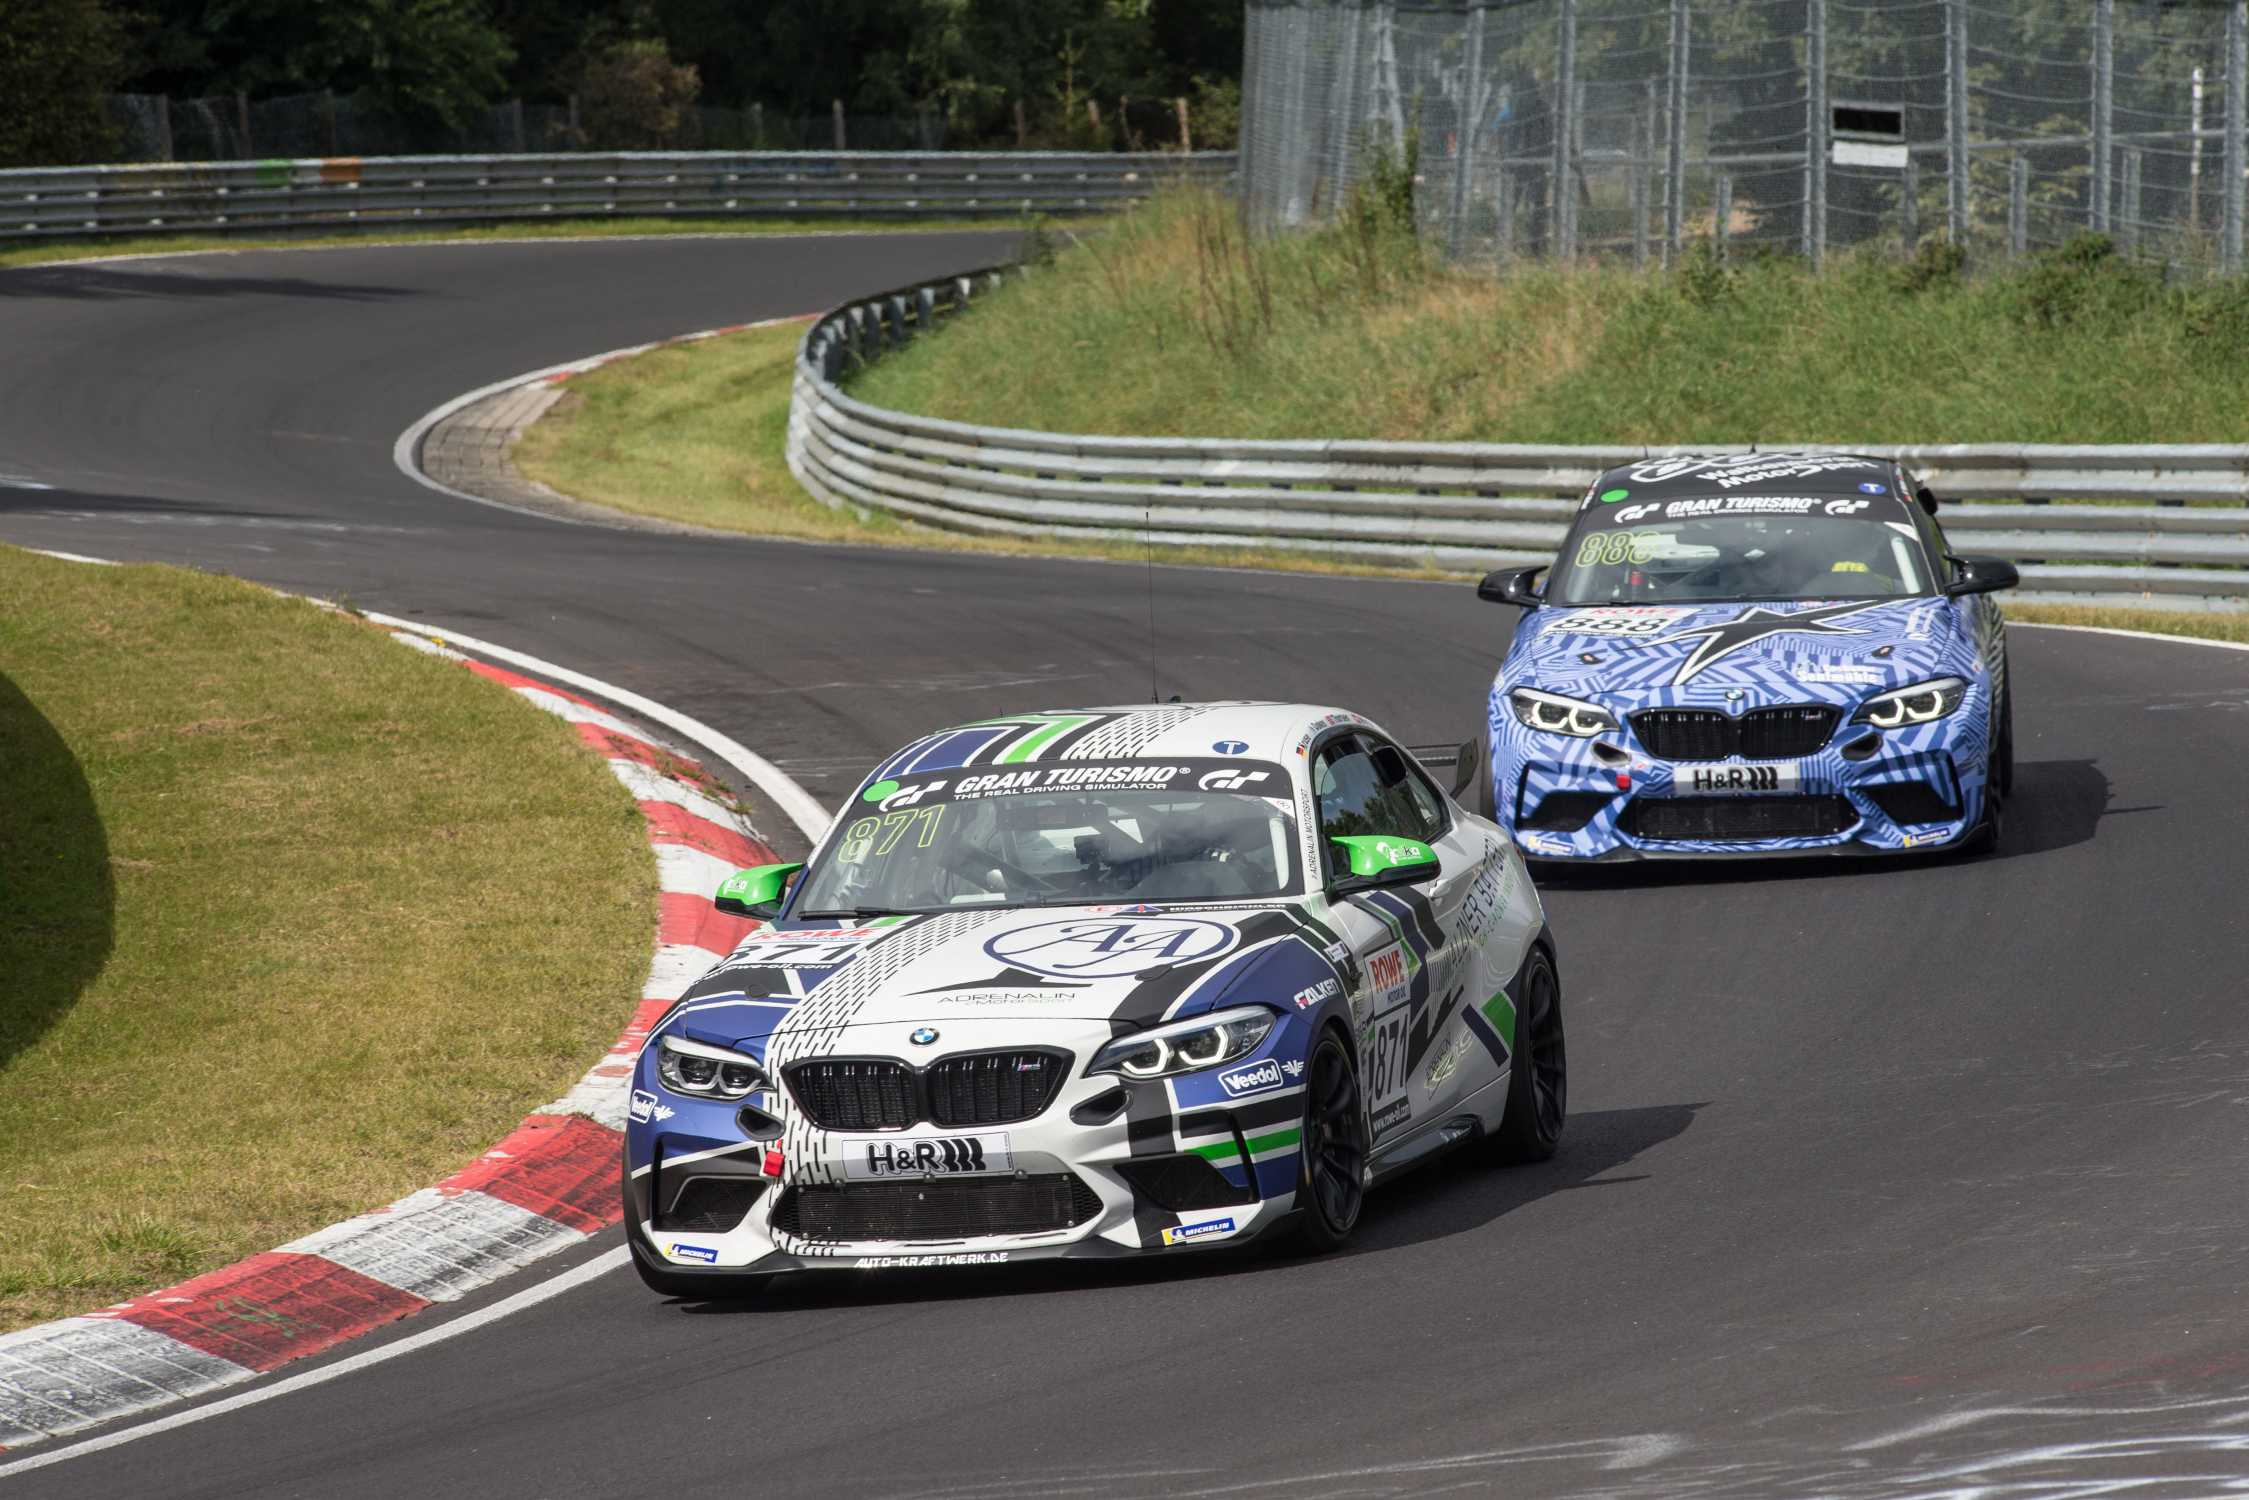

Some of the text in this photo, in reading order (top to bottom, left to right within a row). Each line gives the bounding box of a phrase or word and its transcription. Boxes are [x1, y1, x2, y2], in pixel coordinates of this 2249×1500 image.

[1666, 499, 1720, 514] GRAN
[1553, 618, 1668, 632] 888
[954, 771, 1040, 794] GRAN
[1693, 768, 1745, 791] H&R
[953, 783, 1168, 801] THE REAL DRIVING SIMULATOR
[838, 804, 947, 864] 871
[1370, 950, 1405, 993] ROWE
[936, 993, 1075, 1004] ADRENALIN
[1294, 978, 1340, 1010] FALKEN
[1375, 1013, 1409, 1101] 871
[1224, 1065, 1279, 1090] Veedol
[868, 1143, 942, 1173] H&R
[1185, 1222, 1230, 1236] MICHELIN
[854, 1252, 1009, 1268] AUTO-KRAFTWERK.DE
